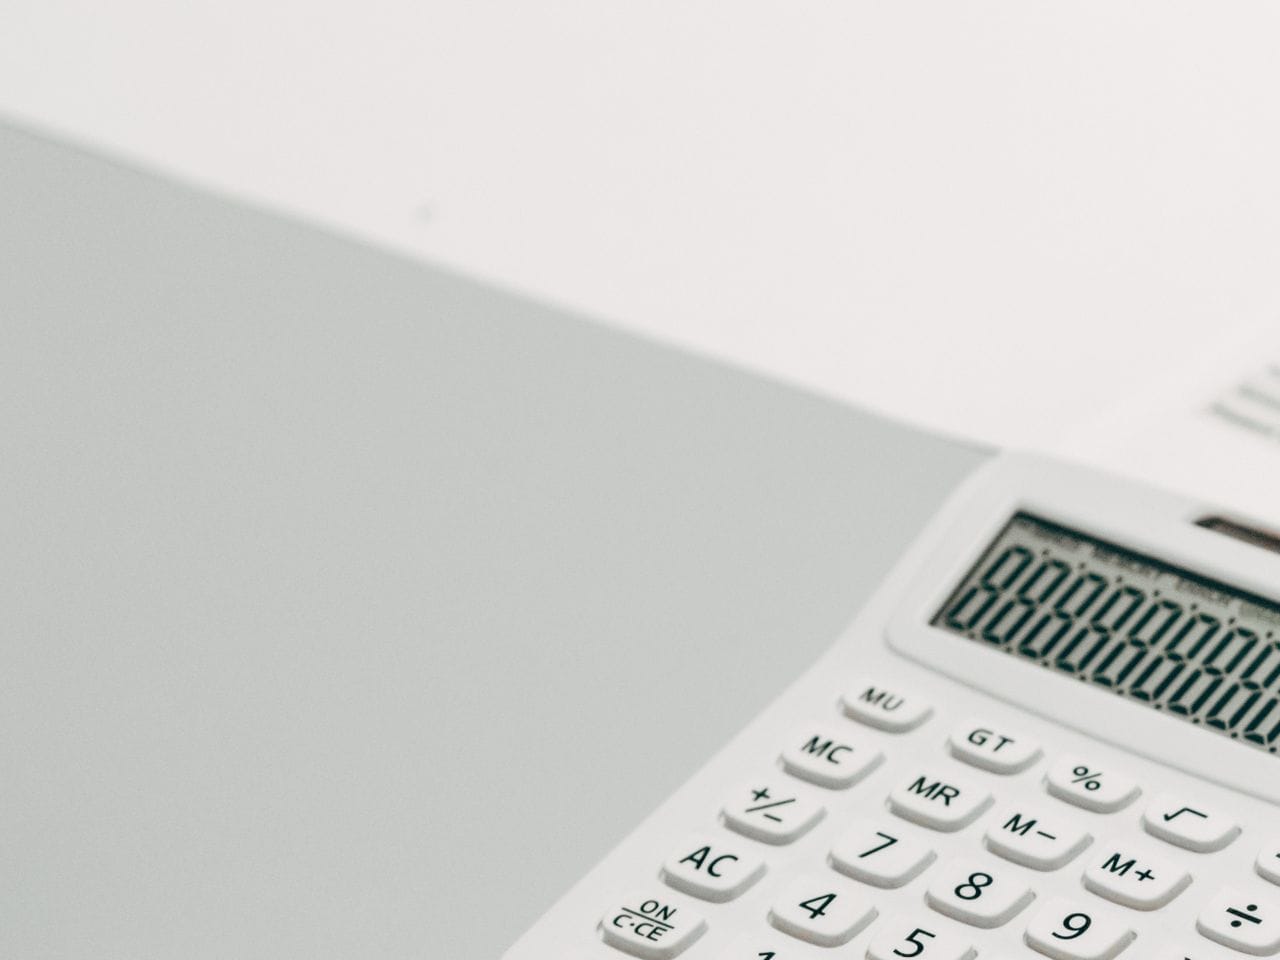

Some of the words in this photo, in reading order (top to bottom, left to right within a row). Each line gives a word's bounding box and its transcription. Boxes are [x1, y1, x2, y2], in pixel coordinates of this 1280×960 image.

[858, 686, 904, 712] MU
[802, 735, 853, 765] MC
[967, 728, 1014, 754] GT
[907, 776, 960, 808] MR
[1073, 766, 1102, 792] %
[858, 831, 899, 859] 7
[679, 845, 739, 878] AC
[1100, 852, 1155, 882] M+
[954, 872, 994, 901] 8
[640, 899, 678, 921] ON
[798, 893, 838, 920] 4
[1051, 912, 1092, 940] 9
[892, 927, 937, 958] 5
